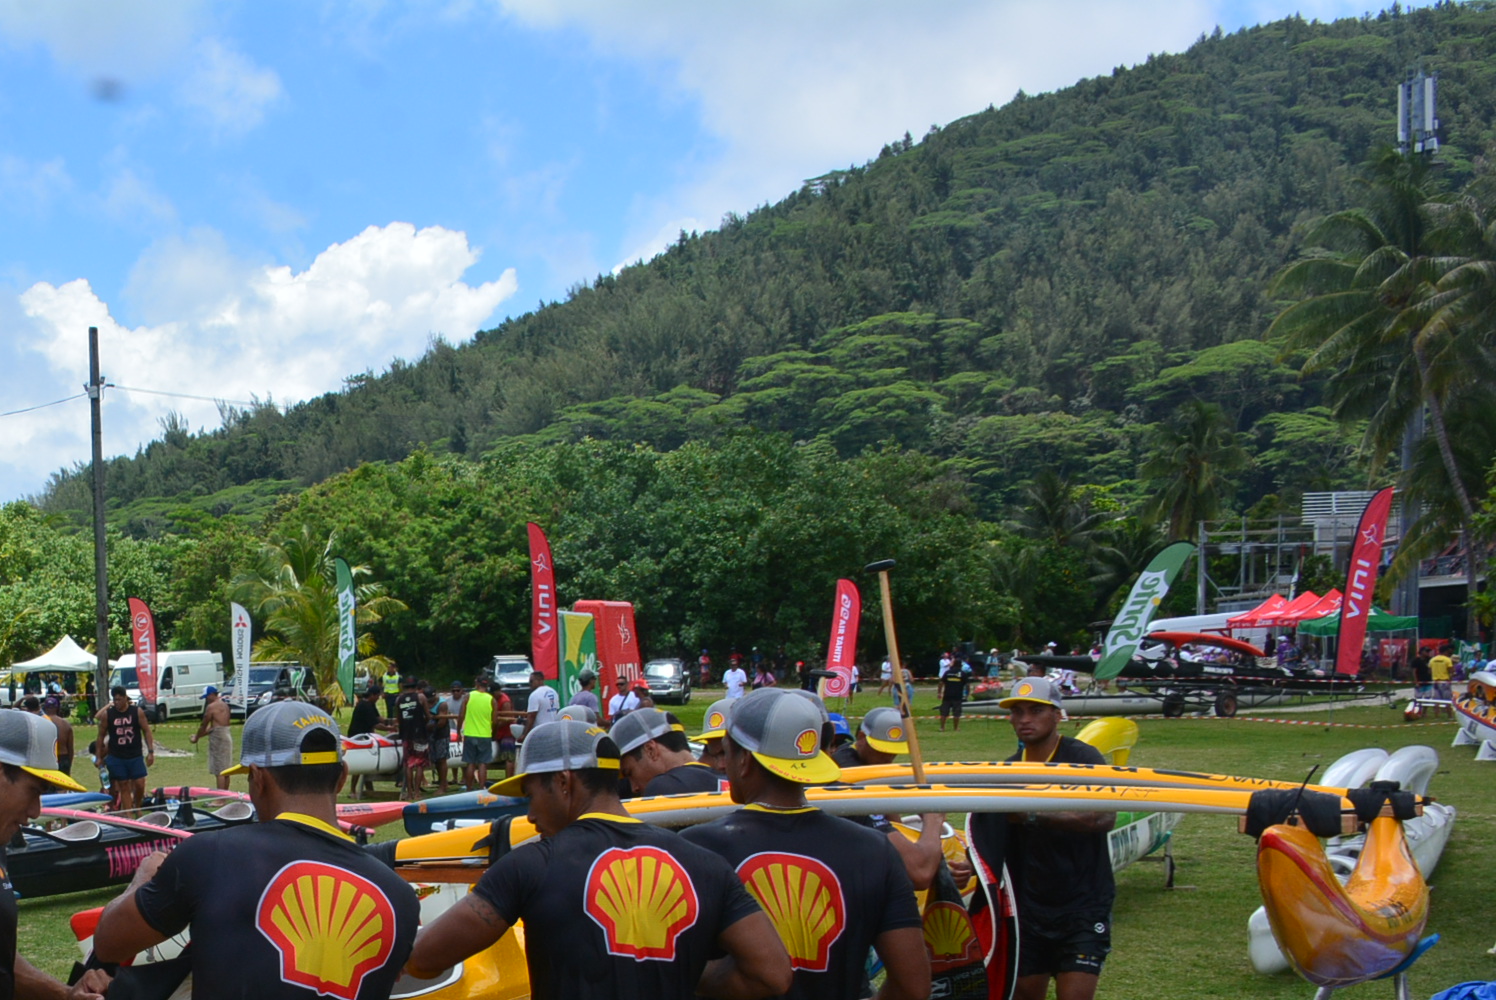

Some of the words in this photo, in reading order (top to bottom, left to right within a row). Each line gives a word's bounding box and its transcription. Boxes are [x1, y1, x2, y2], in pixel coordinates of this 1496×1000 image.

[1346, 558, 1371, 619] VINI
[538, 584, 551, 635] VINI
[837, 619, 846, 634] AIR
[832, 635, 844, 662] TAHITI
[293, 714, 331, 729] TAHITI
